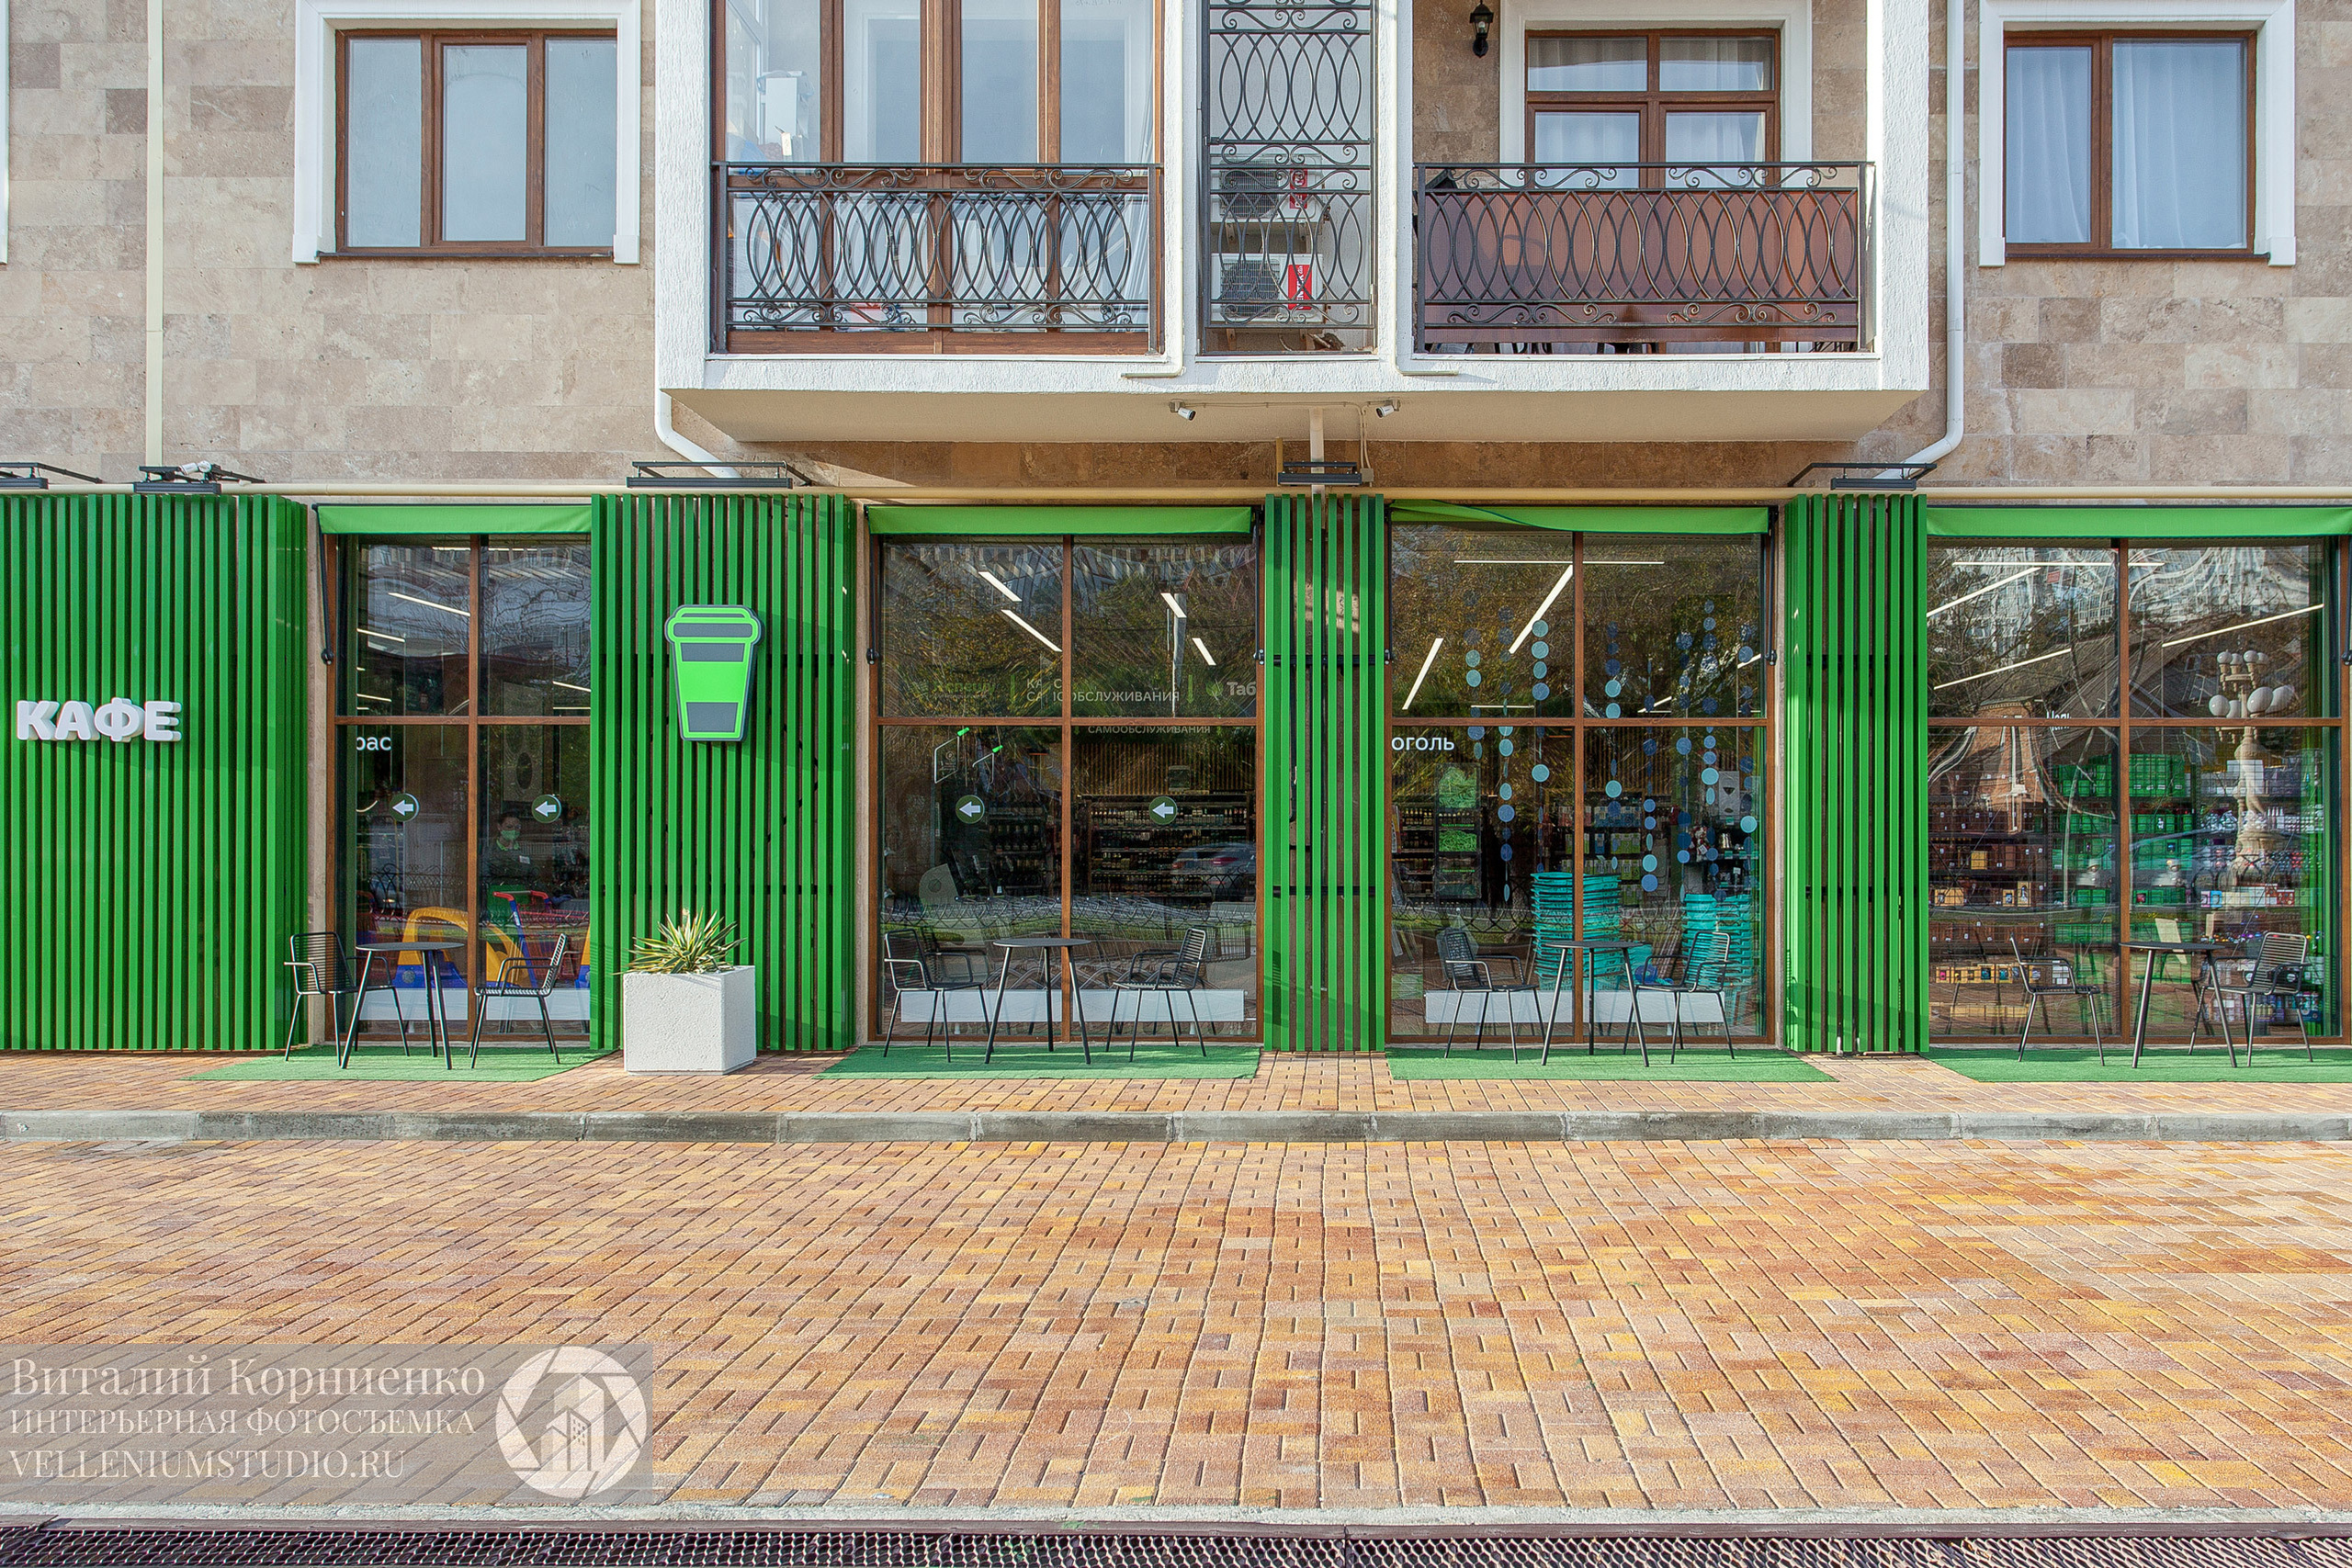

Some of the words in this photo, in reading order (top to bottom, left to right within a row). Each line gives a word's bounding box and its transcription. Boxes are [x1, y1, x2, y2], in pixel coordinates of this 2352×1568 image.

[1026, 691, 1181, 702] САООБСЛУЖИВАНИЯ
[17, 697, 182, 743] КАФЕ
[1391, 737, 1455, 750] оголь
